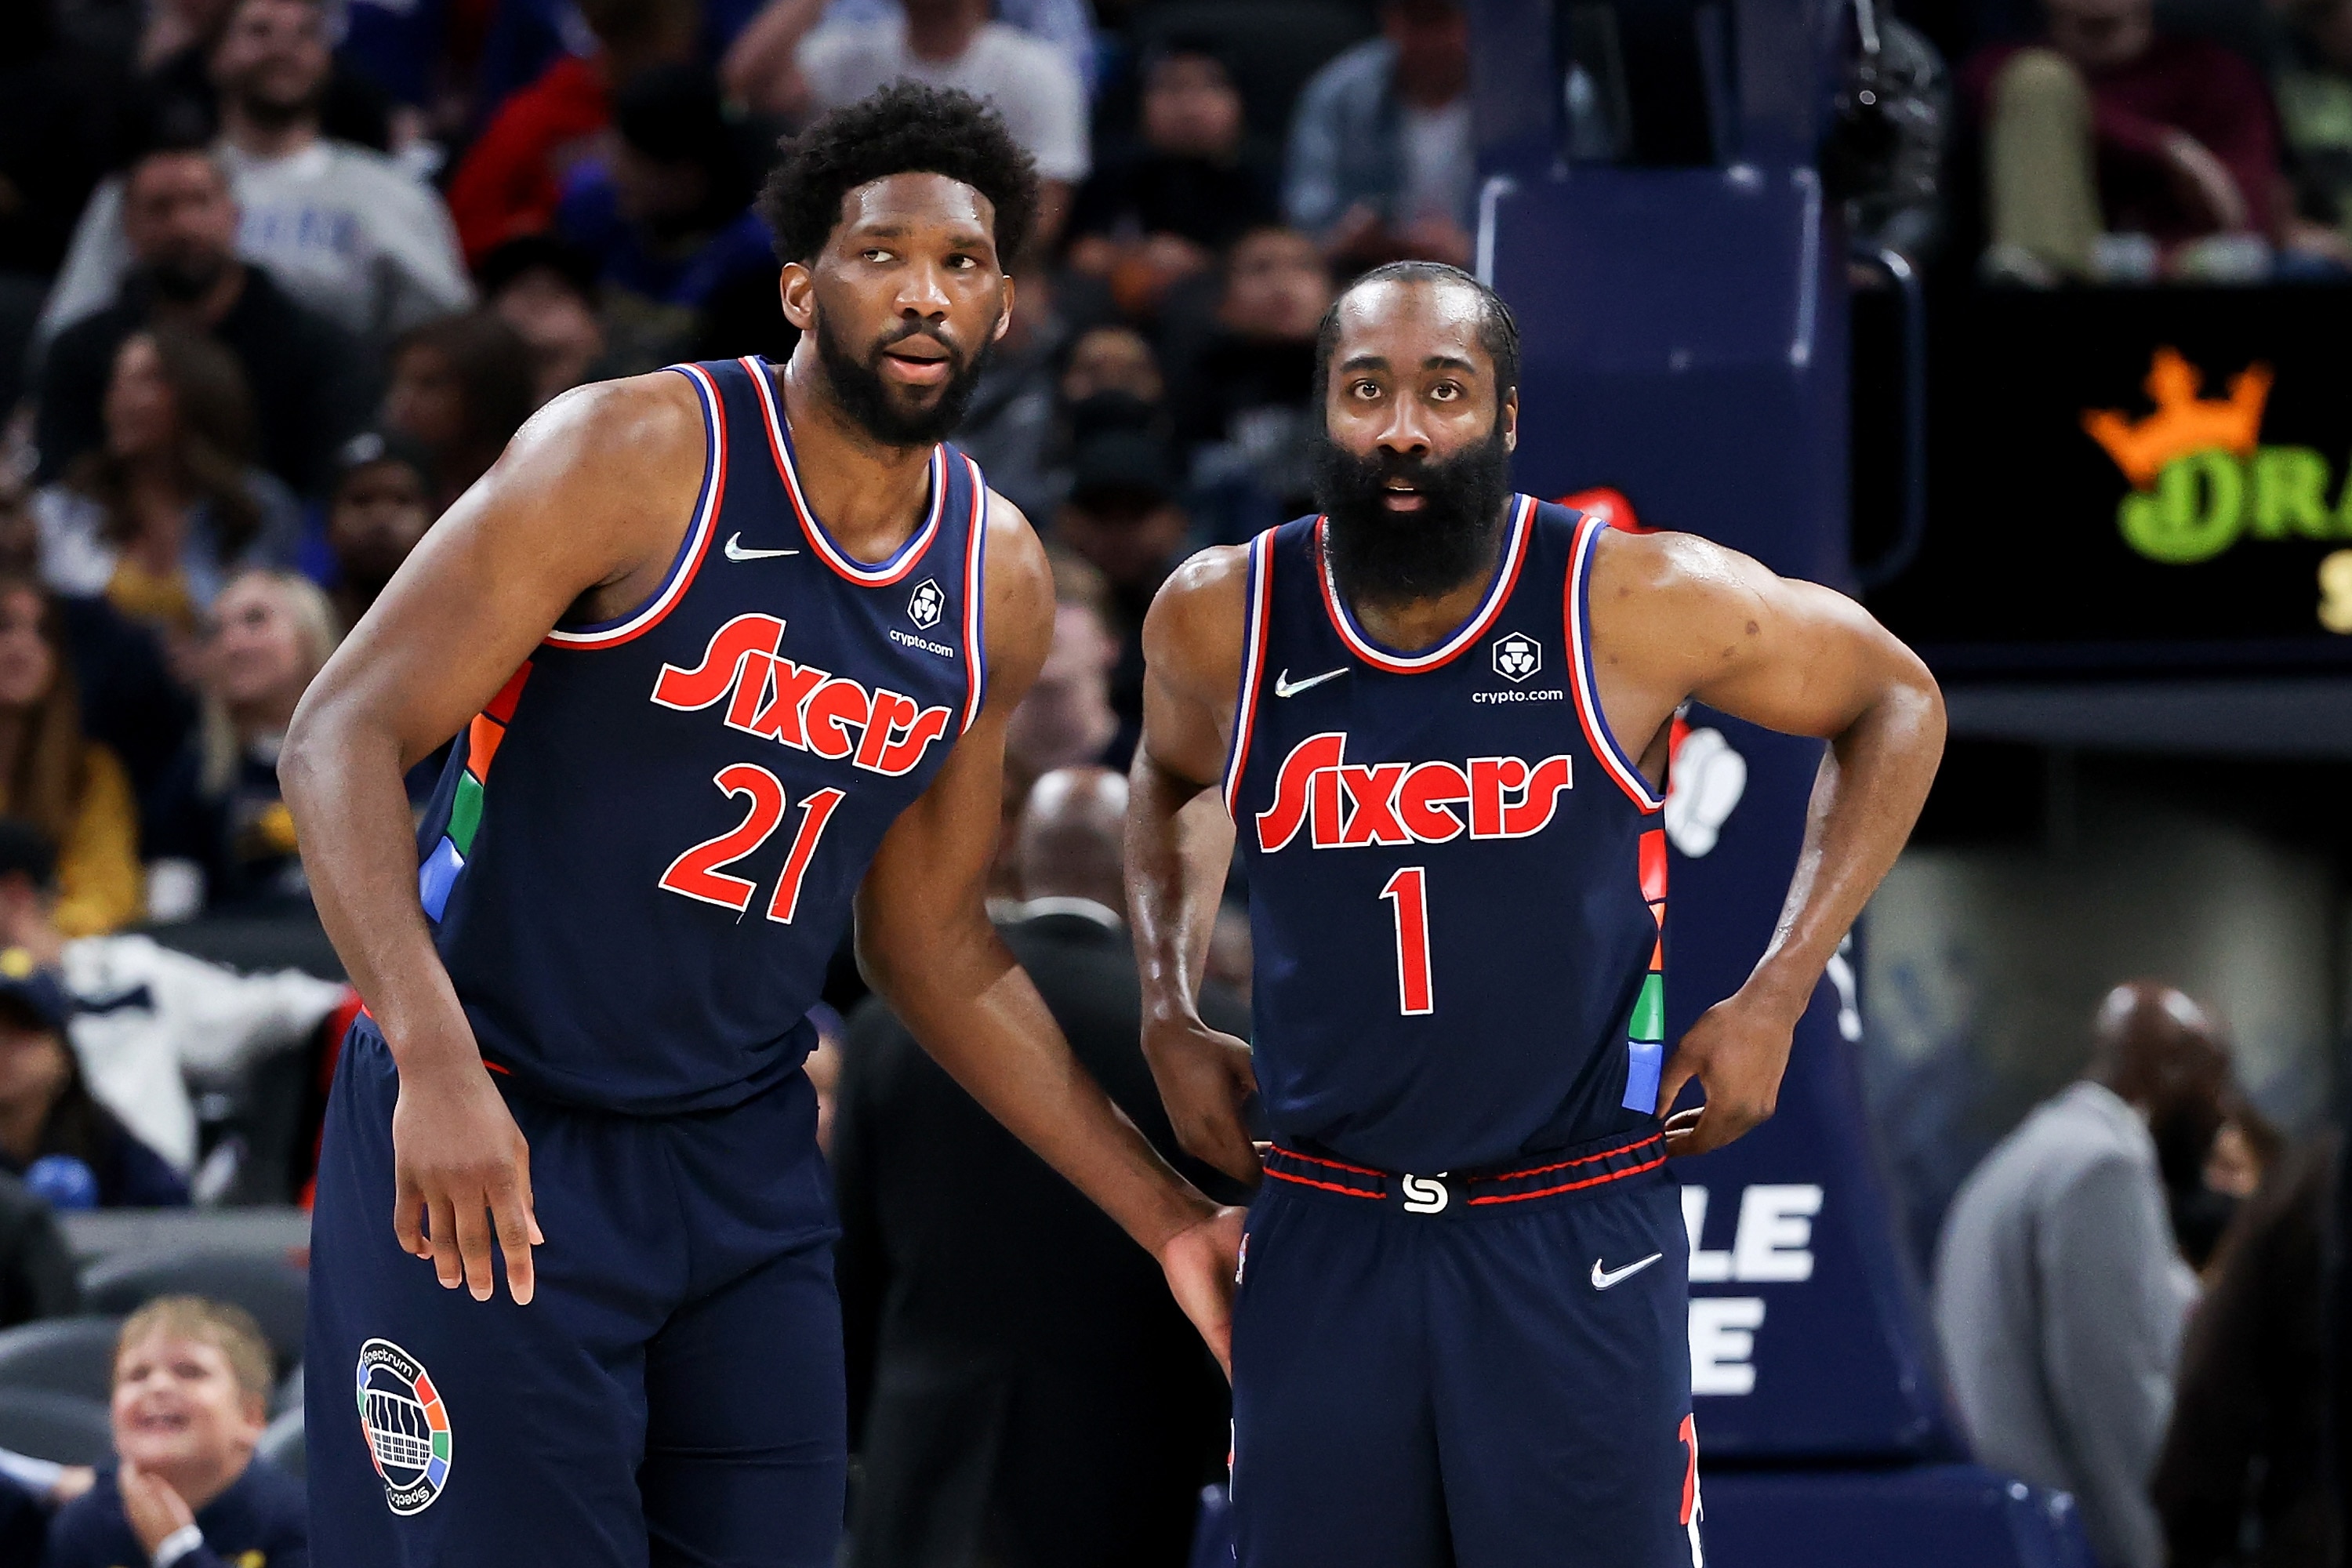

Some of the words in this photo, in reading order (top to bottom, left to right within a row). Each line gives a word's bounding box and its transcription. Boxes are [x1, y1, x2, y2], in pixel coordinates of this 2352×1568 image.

[2118, 445, 2352, 564] DR
[650, 612, 953, 777] Sixers
[890, 630, 953, 658] crypto.com
[1472, 690, 1563, 704] crypto.com
[658, 762, 847, 925] 21
[1255, 731, 1573, 853] Sixers
[1378, 866, 1434, 1016] 1
[363, 1348, 413, 1377] Spectrum
